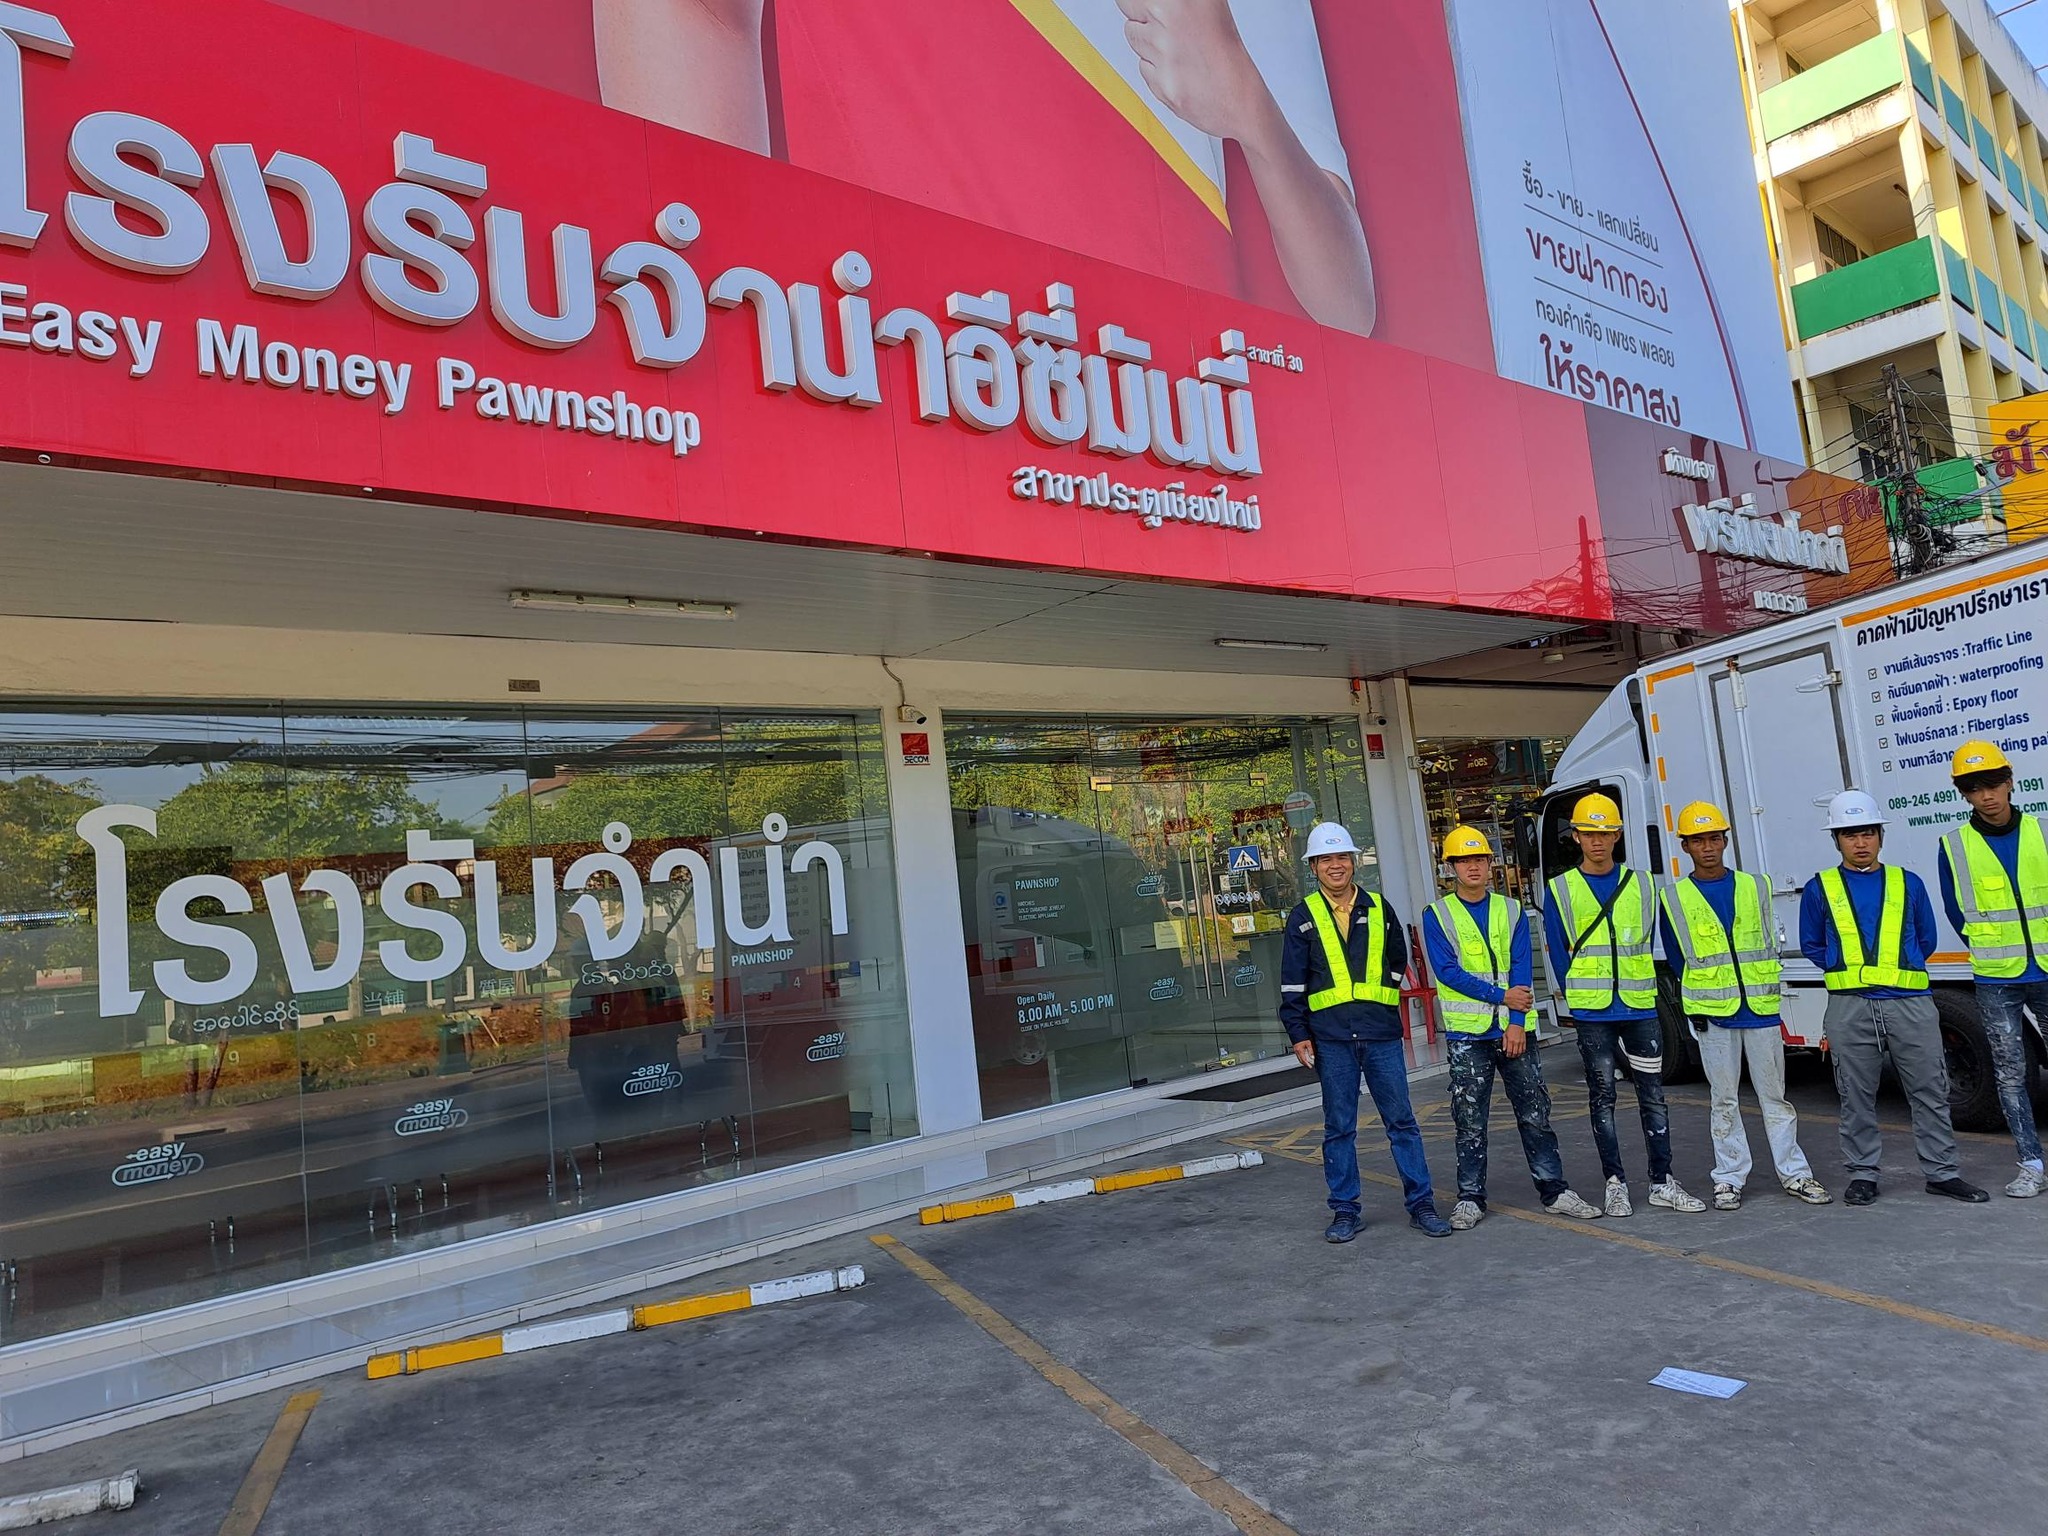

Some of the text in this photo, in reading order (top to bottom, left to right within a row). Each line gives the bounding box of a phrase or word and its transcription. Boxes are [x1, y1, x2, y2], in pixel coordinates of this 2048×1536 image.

[1522, 160, 1543, 199] ซื้อ
[1557, 189, 1584, 218] ขาย
[1597, 209, 1660, 253] แลกเปลี่ยน
[1525, 226, 1669, 313] ขายฝากทอง
[1246, 344, 1304, 373] สาขาที่ 30
[1606, 326, 1638, 355] เพชร
[1639, 339, 1675, 368] พลอย
[0, 284, 702, 457] Easy Money Pawnshop
[1012, 466, 1263, 532] สาขาประตูเชียงใหม่
[2006, 629, 2033, 645] Line
[1959, 654, 2044, 684] waterproofing
[1953, 693, 1988, 714] Epoxy
[1990, 686, 2019, 704] floor
[1967, 711, 2030, 735] Fiberglass
[904, 755, 929, 764] SECOM
[1888, 776, 2045, 811] 089-245 4991 1991
[1015, 877, 1060, 890] PAWNSHOP
[76, 804, 849, 1018] โรงรับจำนำ
[731, 948, 794, 967] PAWNSHOP
[1156, 976, 1176, 988] easy
[1016, 990, 1055, 1006] Open Daily
[1018, 1006, 1043, 1024] 8.00
[1045, 1002, 1062, 1019] AM
[1070, 997, 1095, 1014] 5.00
[1097, 993, 1114, 1009] PM
[818, 1031, 845, 1045] easy
[637, 1062, 671, 1077] easy
[629, 1075, 676, 1093] money
[412, 1098, 454, 1114] easy
[402, 1111, 460, 1132] money
[134, 1141, 186, 1161] easy
[122, 1158, 194, 1182] money
